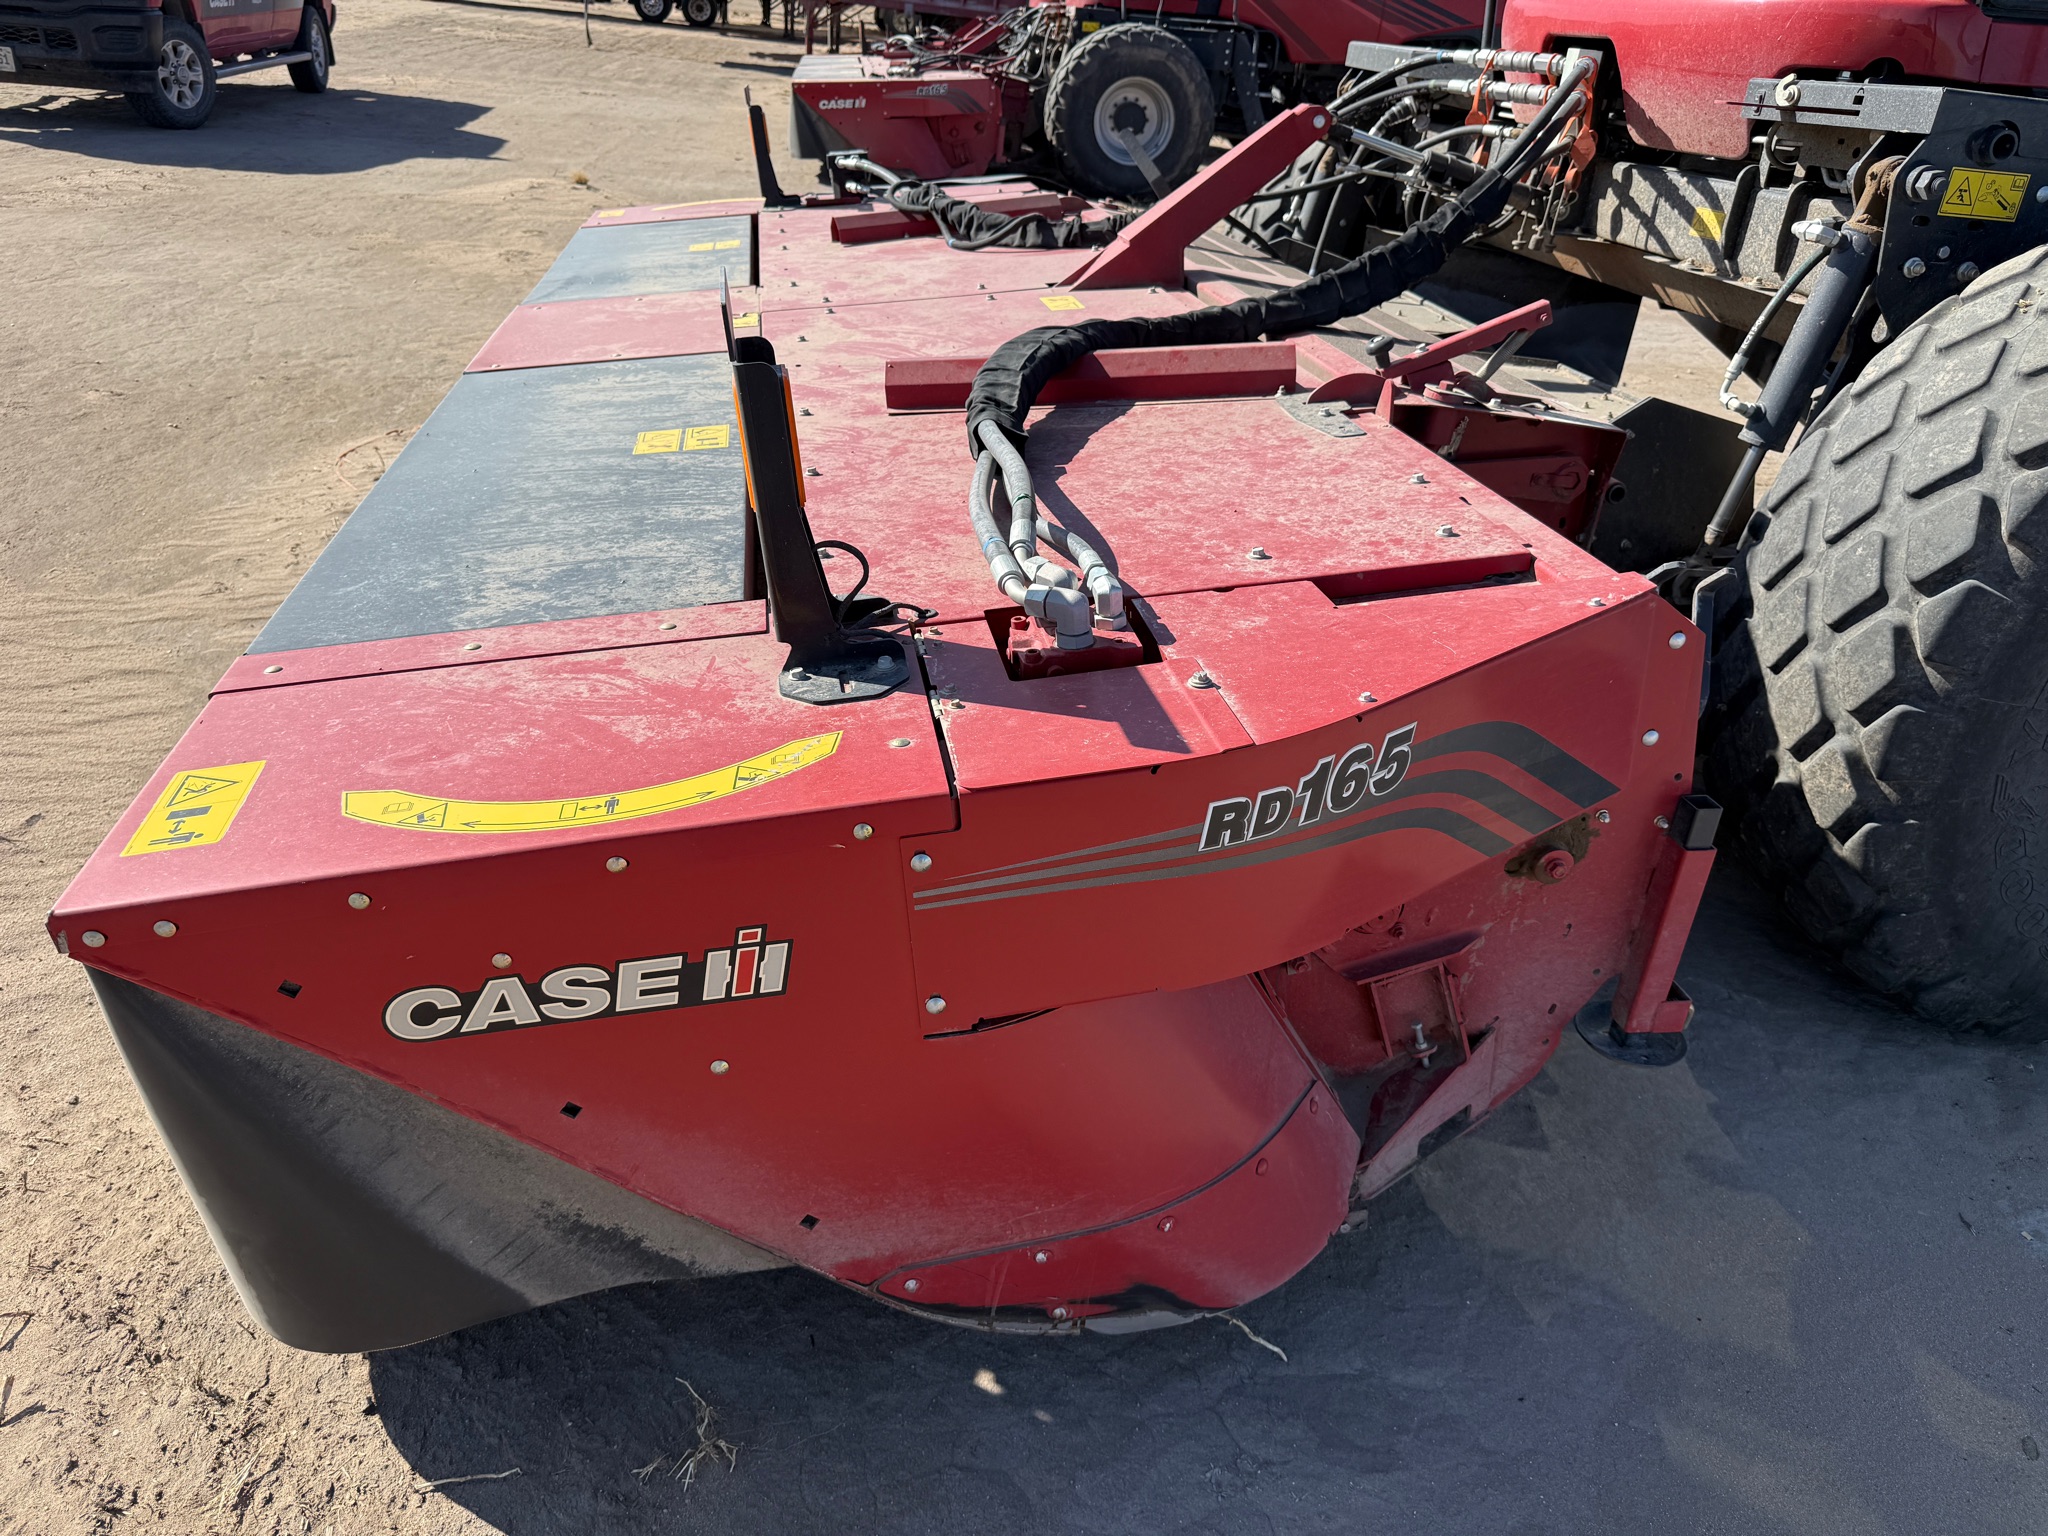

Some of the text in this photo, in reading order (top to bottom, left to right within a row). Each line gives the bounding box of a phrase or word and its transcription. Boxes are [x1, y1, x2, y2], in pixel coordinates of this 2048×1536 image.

[818, 98, 854, 110] CASE
[916, 83, 949, 96] RD165
[1198, 721, 1418, 851] RD165
[384, 925, 790, 1041] CASE IH
